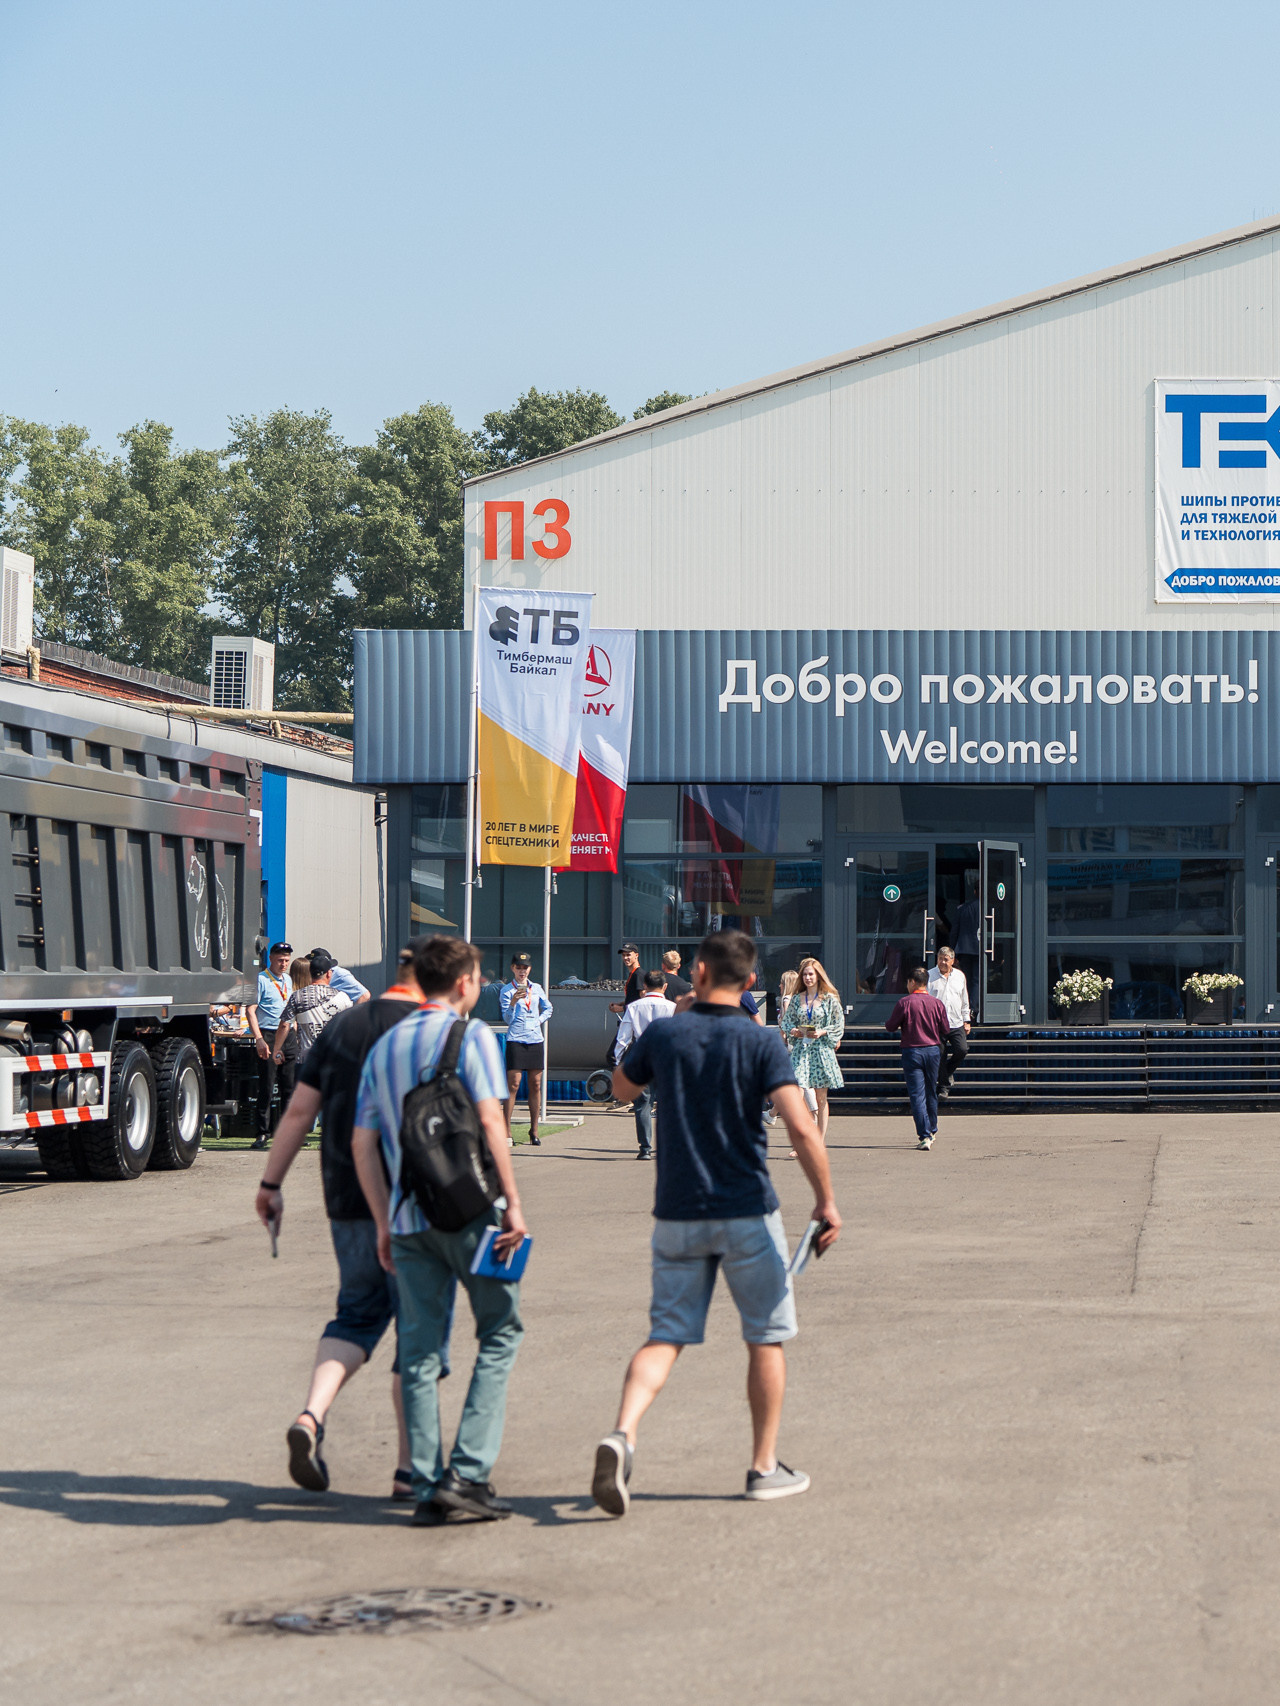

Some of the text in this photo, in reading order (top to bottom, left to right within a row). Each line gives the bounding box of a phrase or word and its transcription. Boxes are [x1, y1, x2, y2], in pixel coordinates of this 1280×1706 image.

[1180, 495, 1227, 508] ШИПЫ
[1180, 511, 1209, 526] ДЛЯ
[1212, 509, 1278, 524] ТЯЖЕЛОЙ
[1180, 529, 1190, 541] И
[1194, 529, 1280, 541] ТЕХНОЛОГИЯ
[1171, 574, 1216, 588] ДОБРО
[523, 608, 580, 646] ТБ
[496, 650, 572, 665] Тимбермаш
[510, 663, 557, 676] Байкал
[718, 655, 1260, 718] Добро пожаловать!
[880, 726, 1078, 765] Welcome!
[485, 822, 559, 834] 20 ЛЕТ В МИРЕ
[485, 836, 559, 848] СПЕЦТЕХНИКИ
[570, 846, 603, 854] ЕНЯЕТ
